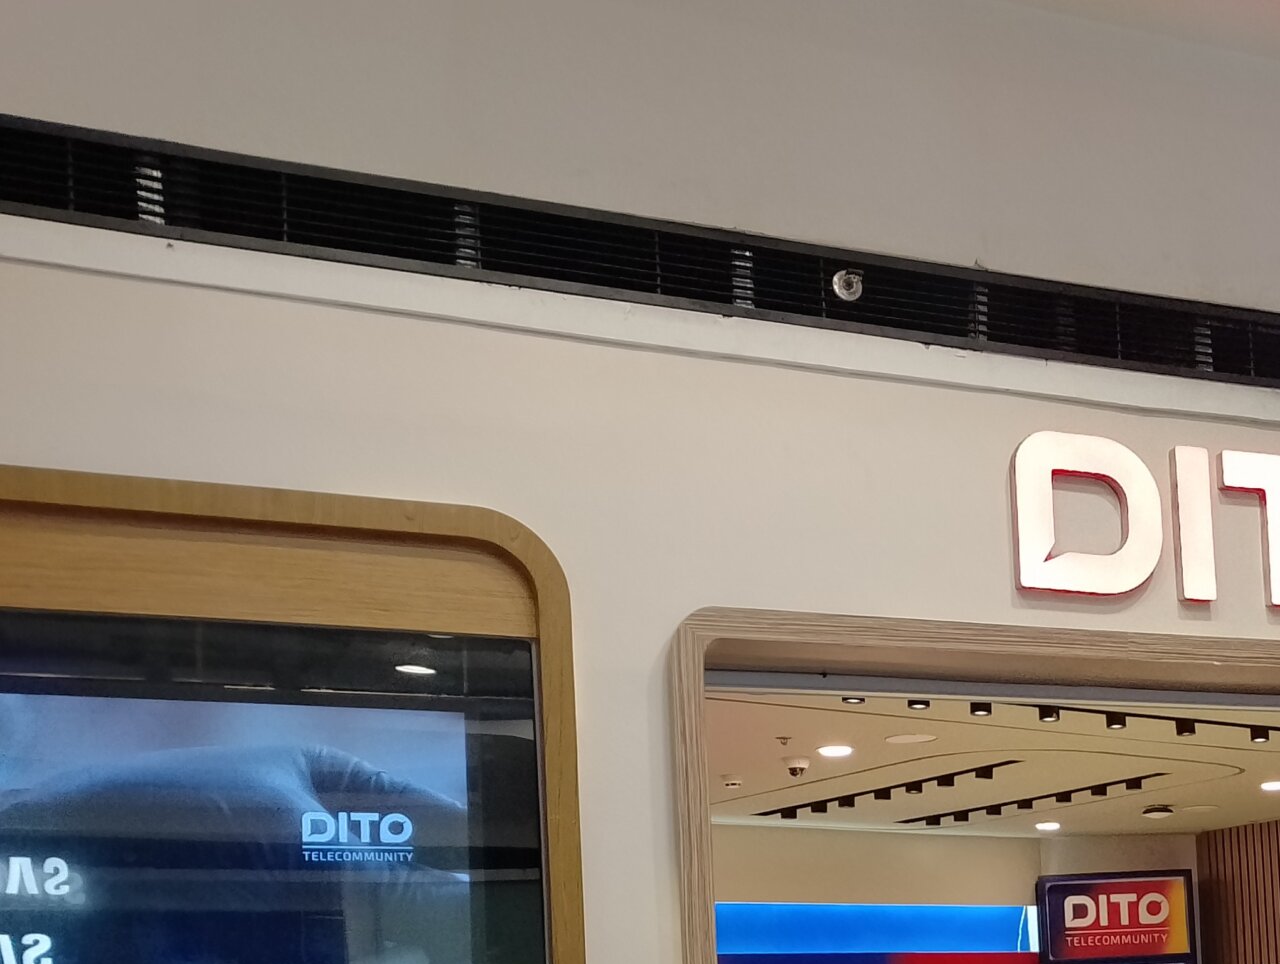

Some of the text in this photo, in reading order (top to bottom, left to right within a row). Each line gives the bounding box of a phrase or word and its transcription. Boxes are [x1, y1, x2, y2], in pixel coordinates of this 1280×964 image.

[301, 811, 414, 843] DITO
[302, 851, 414, 863] TELECOMMUNITY
[1064, 893, 1170, 929] DITO
[1066, 933, 1169, 947] TELECOMMUNITY
